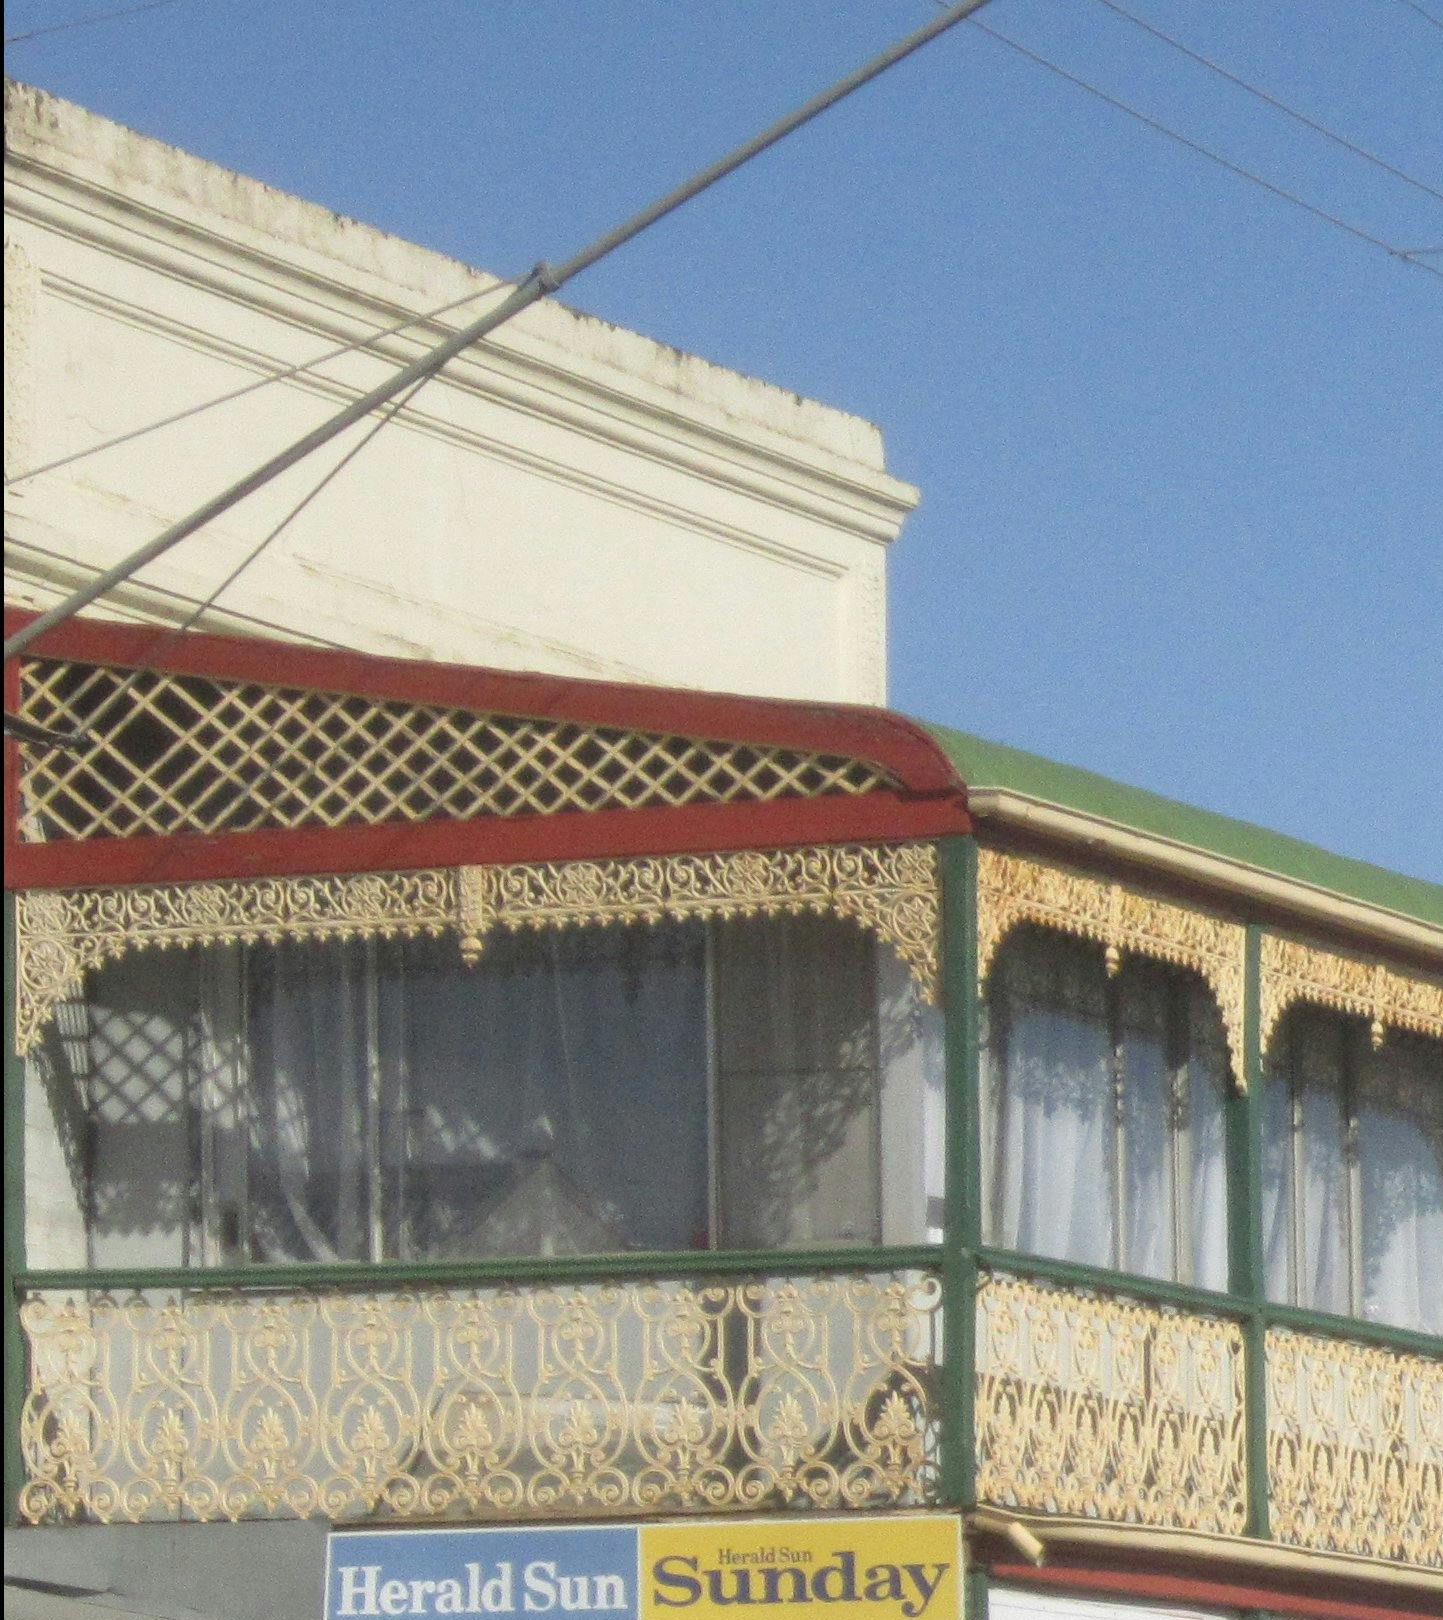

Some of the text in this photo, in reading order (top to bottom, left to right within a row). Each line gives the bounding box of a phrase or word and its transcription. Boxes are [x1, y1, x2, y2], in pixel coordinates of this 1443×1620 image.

[652, 1550, 950, 1617] Sunday
[717, 1547, 813, 1566] Herald Sun
[336, 1560, 628, 1617] Herald Sun
